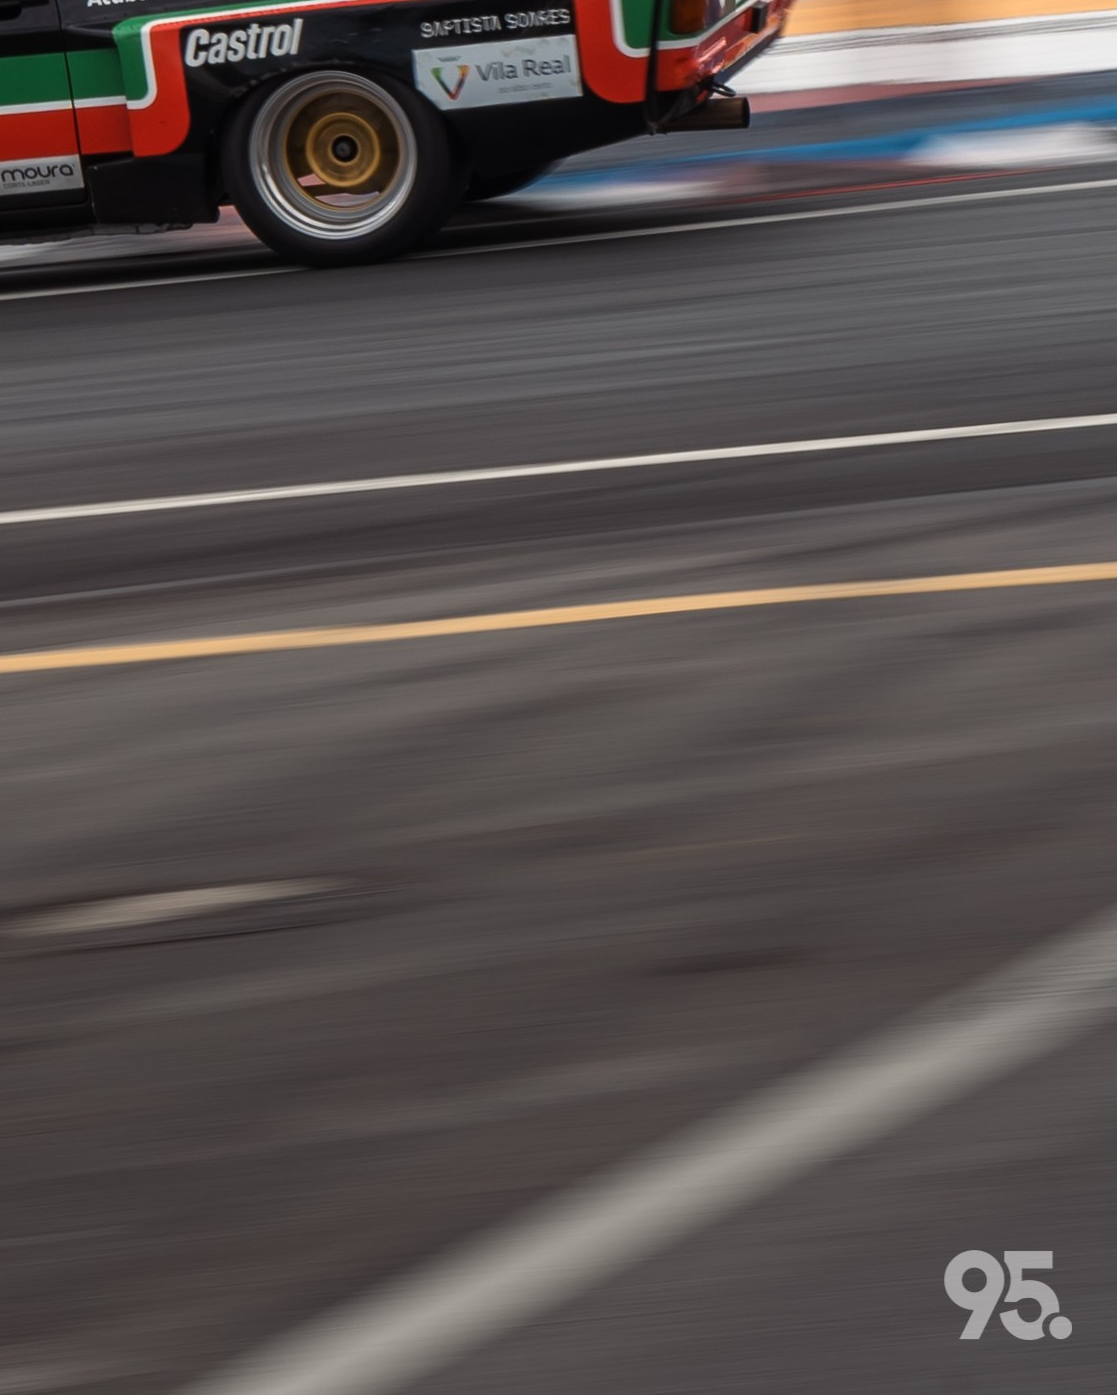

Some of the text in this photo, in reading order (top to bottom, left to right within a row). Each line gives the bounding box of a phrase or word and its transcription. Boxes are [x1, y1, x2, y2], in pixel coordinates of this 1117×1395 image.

[185, 18, 303, 67] Castrol
[475, 54, 571, 82] Vila Real
[1, 164, 74, 182] moura
